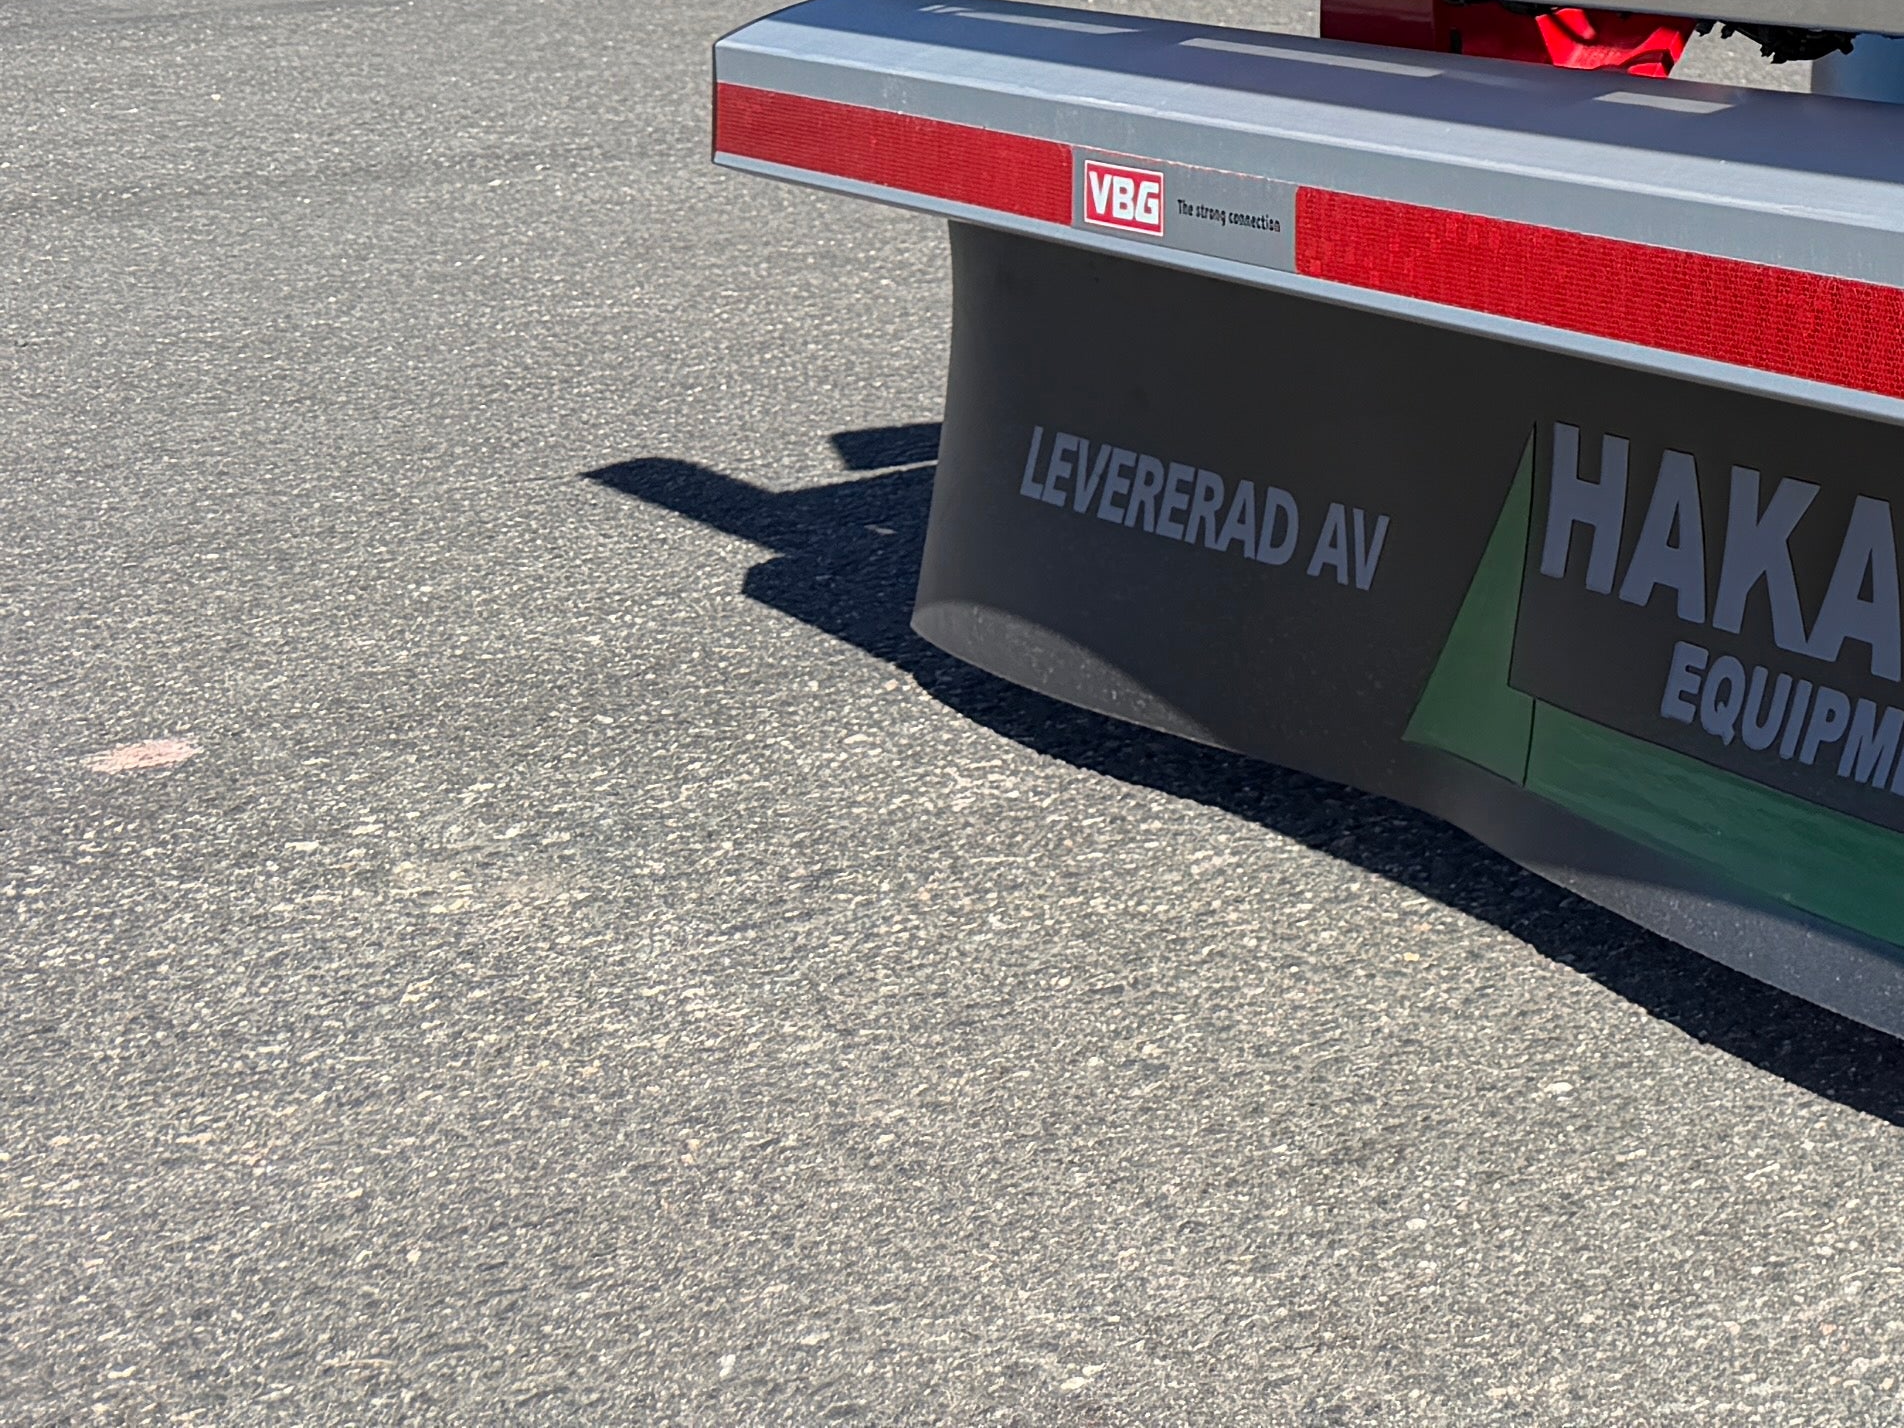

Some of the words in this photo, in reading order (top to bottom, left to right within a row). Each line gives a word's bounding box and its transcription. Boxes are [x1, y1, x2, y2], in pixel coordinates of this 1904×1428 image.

[1088, 170, 1160, 224] VBG
[1177, 199, 1194, 217] The
[1195, 206, 1226, 227] strong
[1229, 212, 1281, 233] connection
[1020, 426, 1299, 565] LEVERERAD
[1307, 501, 1392, 592] AV
